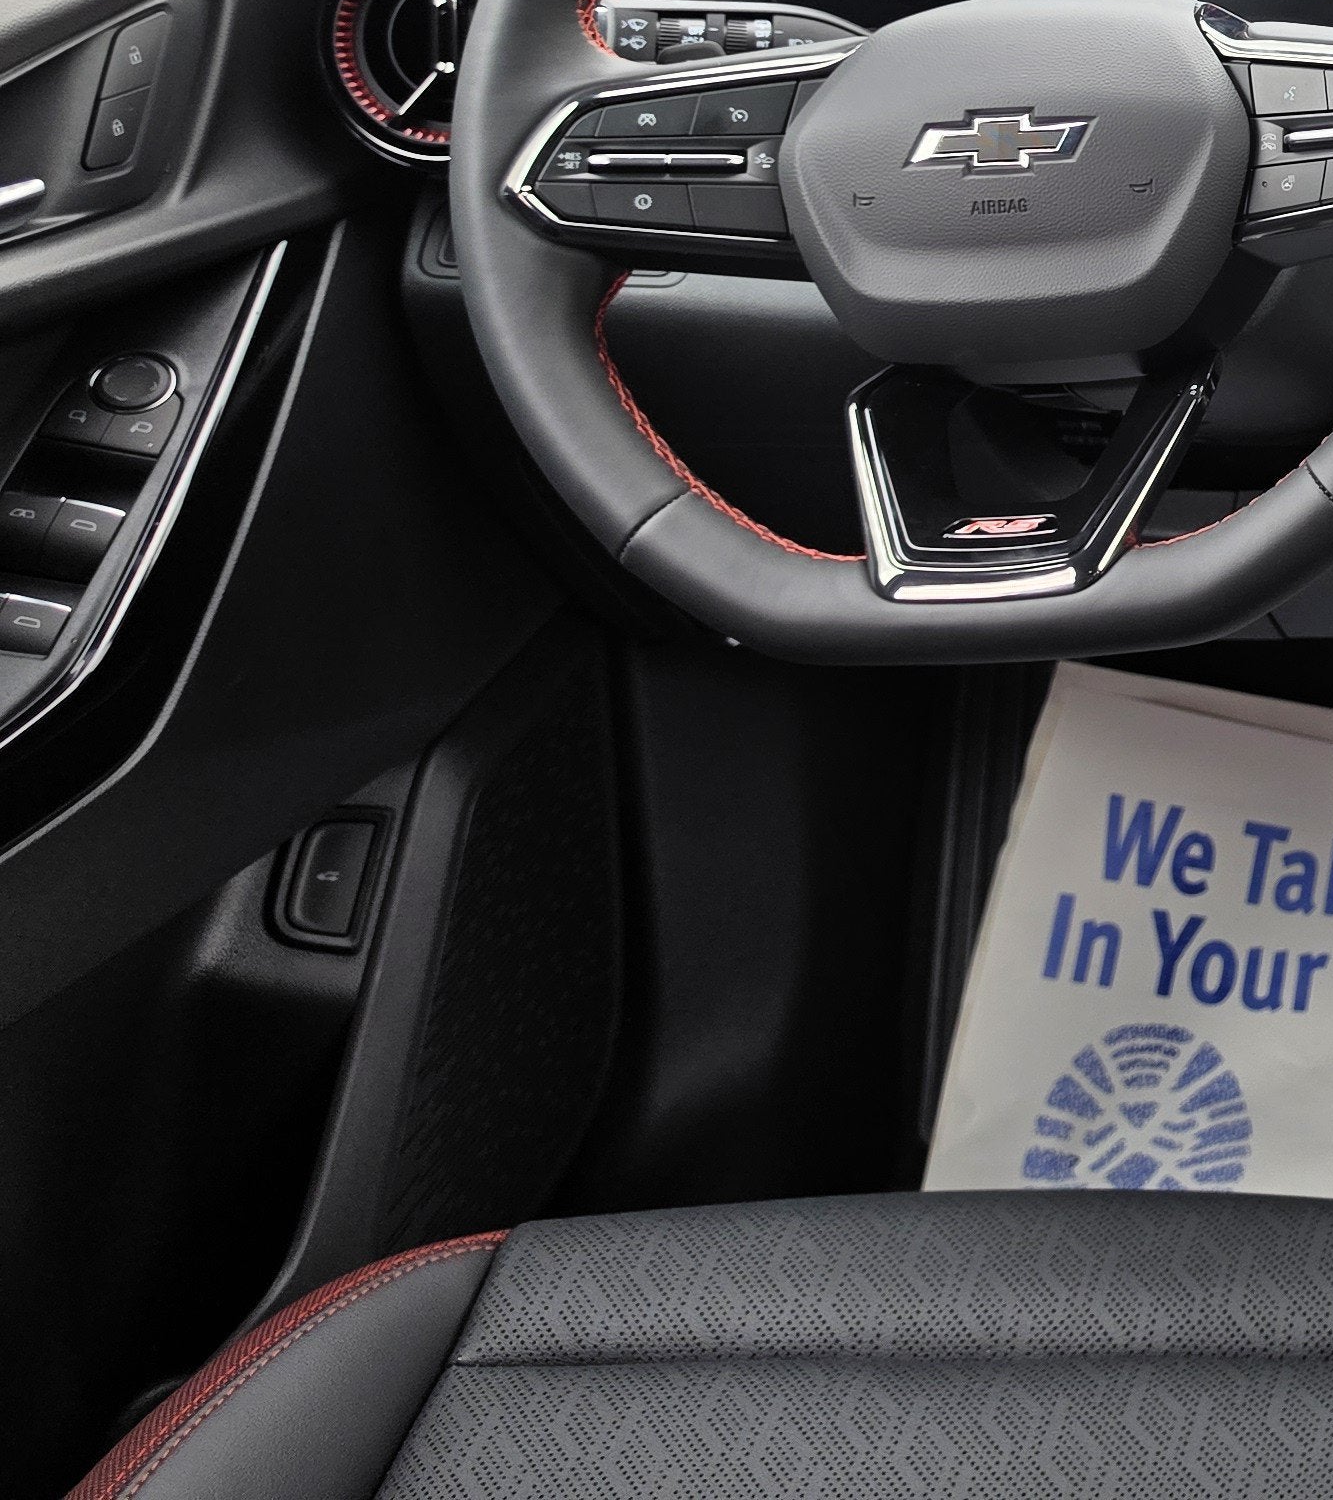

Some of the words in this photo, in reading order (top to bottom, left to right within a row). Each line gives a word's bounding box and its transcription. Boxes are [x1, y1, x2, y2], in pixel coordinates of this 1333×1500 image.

[971, 198, 1028, 215] AIRBAG
[954, 518, 1047, 534] RS
[1102, 793, 1215, 894] We
[1042, 893, 1122, 988] In
[1152, 910, 1328, 1012] Your
